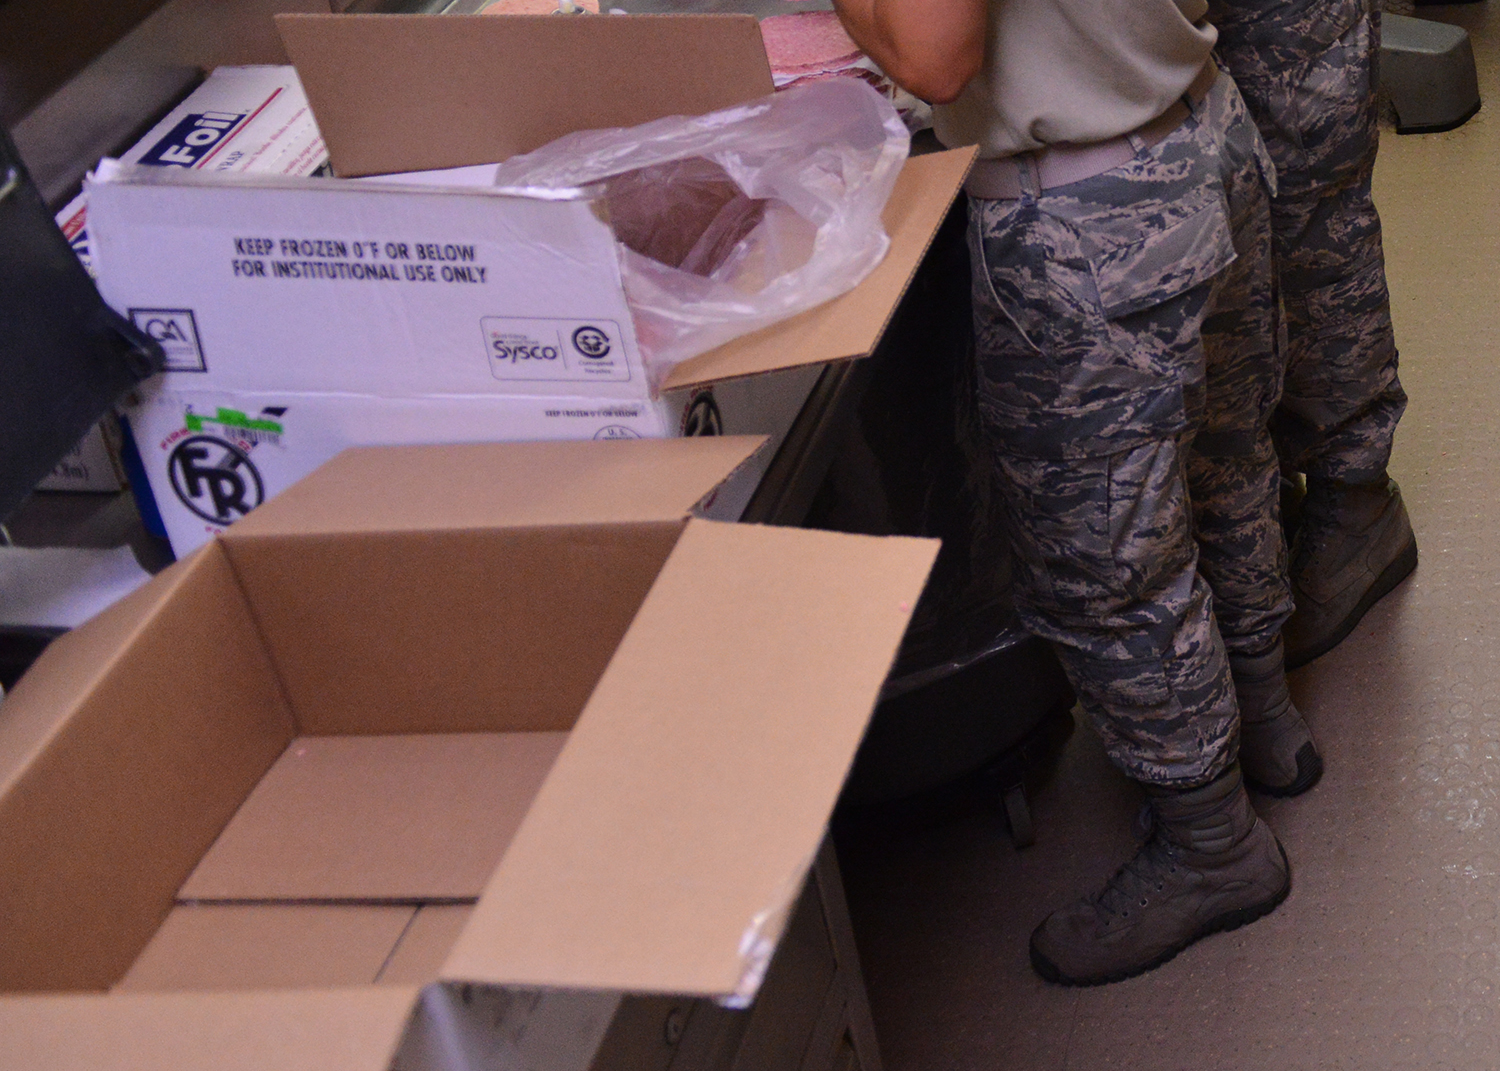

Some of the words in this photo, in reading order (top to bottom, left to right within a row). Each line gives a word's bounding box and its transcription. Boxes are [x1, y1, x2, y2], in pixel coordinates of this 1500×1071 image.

[158, 111, 240, 164] Foil
[234, 237, 274, 256] KEEP
[280, 238, 348, 258] FROZEN
[385, 242, 409, 261] OR
[415, 242, 475, 262] BELOW
[231, 259, 266, 278] FOR
[271, 260, 400, 281] INSTITUTIONAL
[404, 264, 437, 282] USE
[441, 265, 488, 284] ONLY
[492, 340, 558, 364] Sysco
